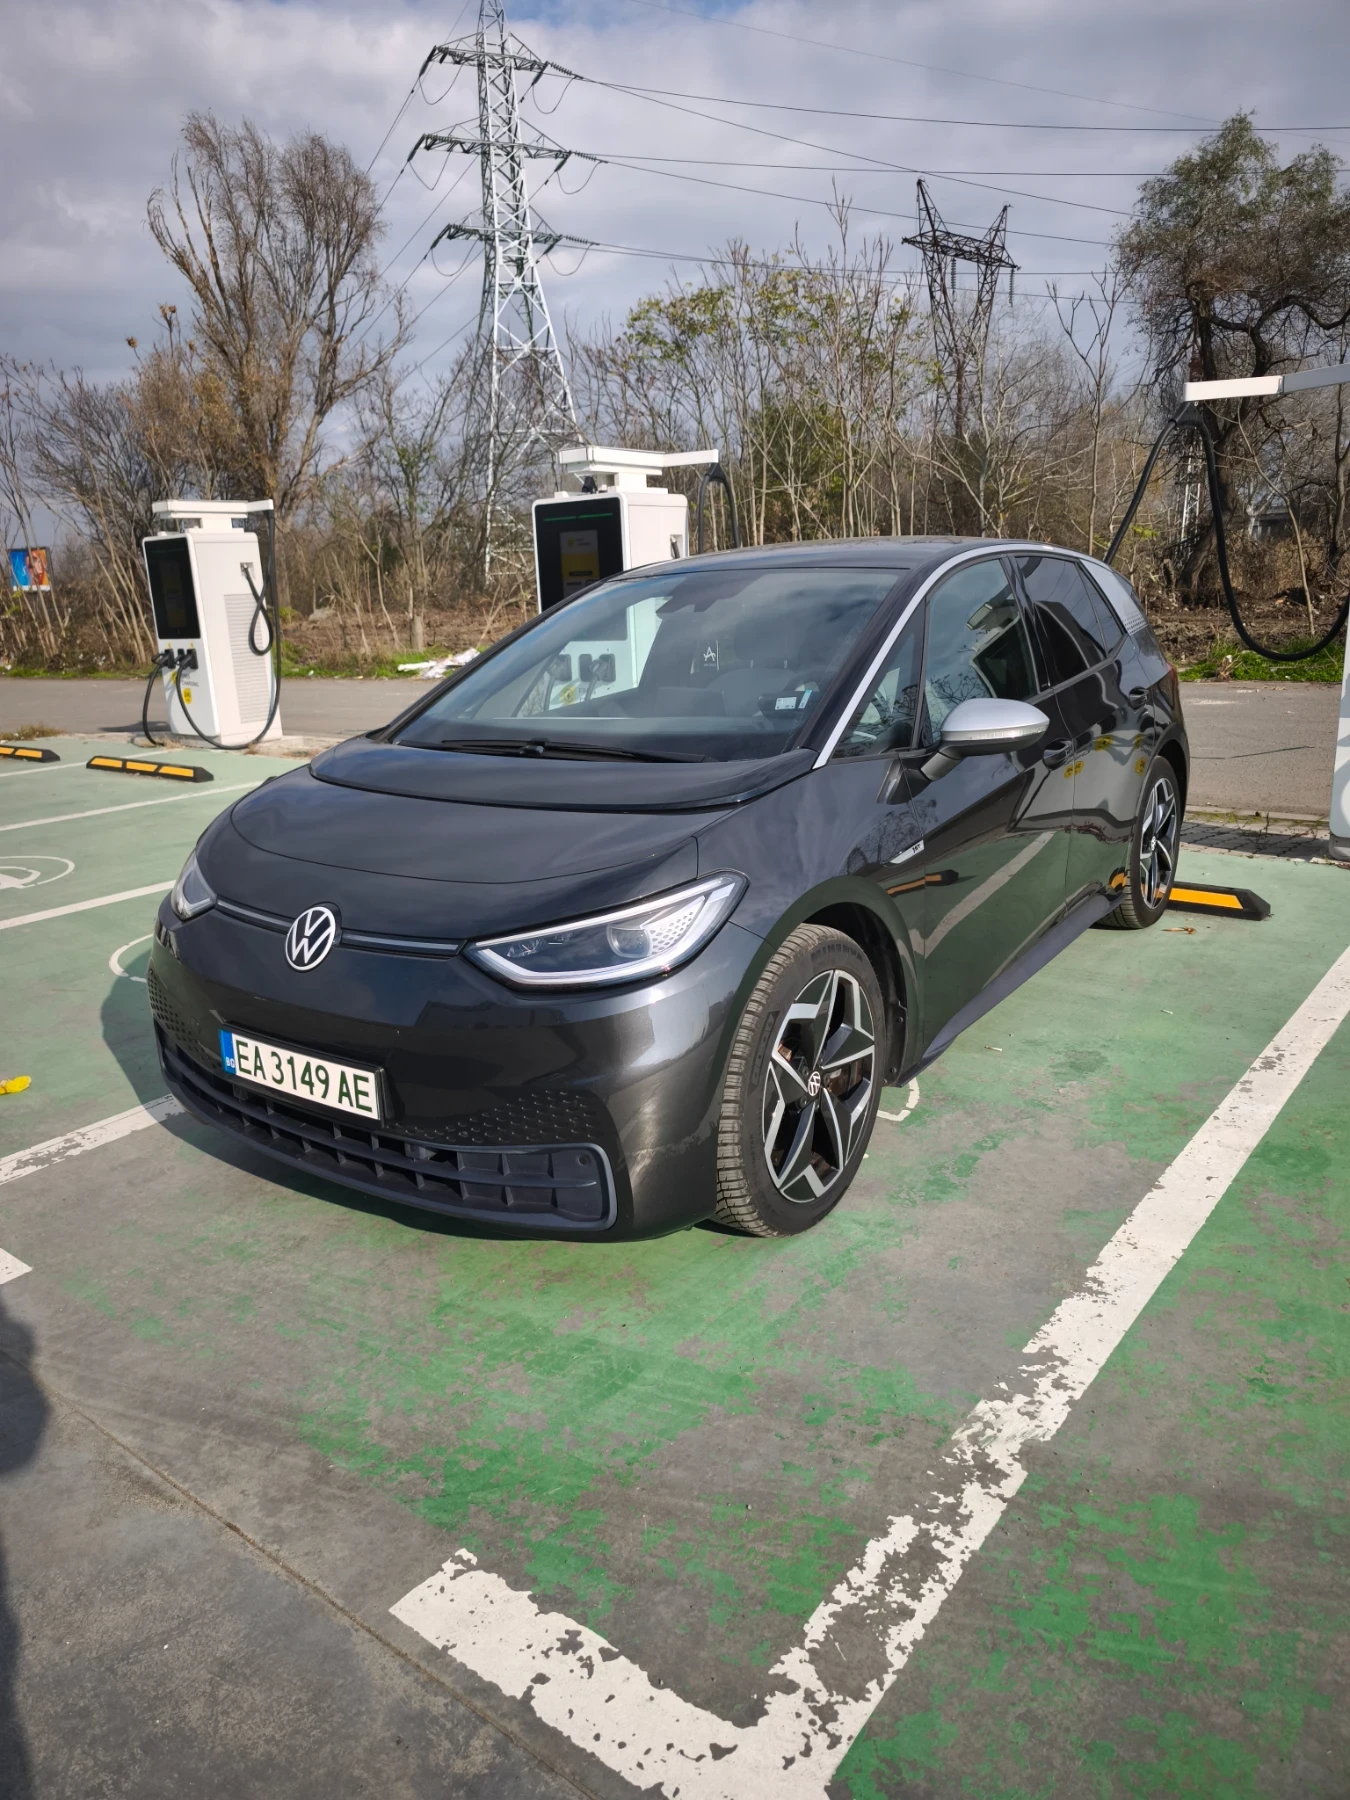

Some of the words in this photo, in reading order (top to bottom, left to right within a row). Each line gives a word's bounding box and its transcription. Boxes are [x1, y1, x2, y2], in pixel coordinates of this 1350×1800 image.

[285, 906, 336, 971] VW
[811, 943, 863, 962] MINERVA
[226, 1057, 235, 1068] BG
[235, 1039, 267, 1080] EA
[270, 1051, 330, 1099] 3149
[337, 1070, 373, 1113] AE
